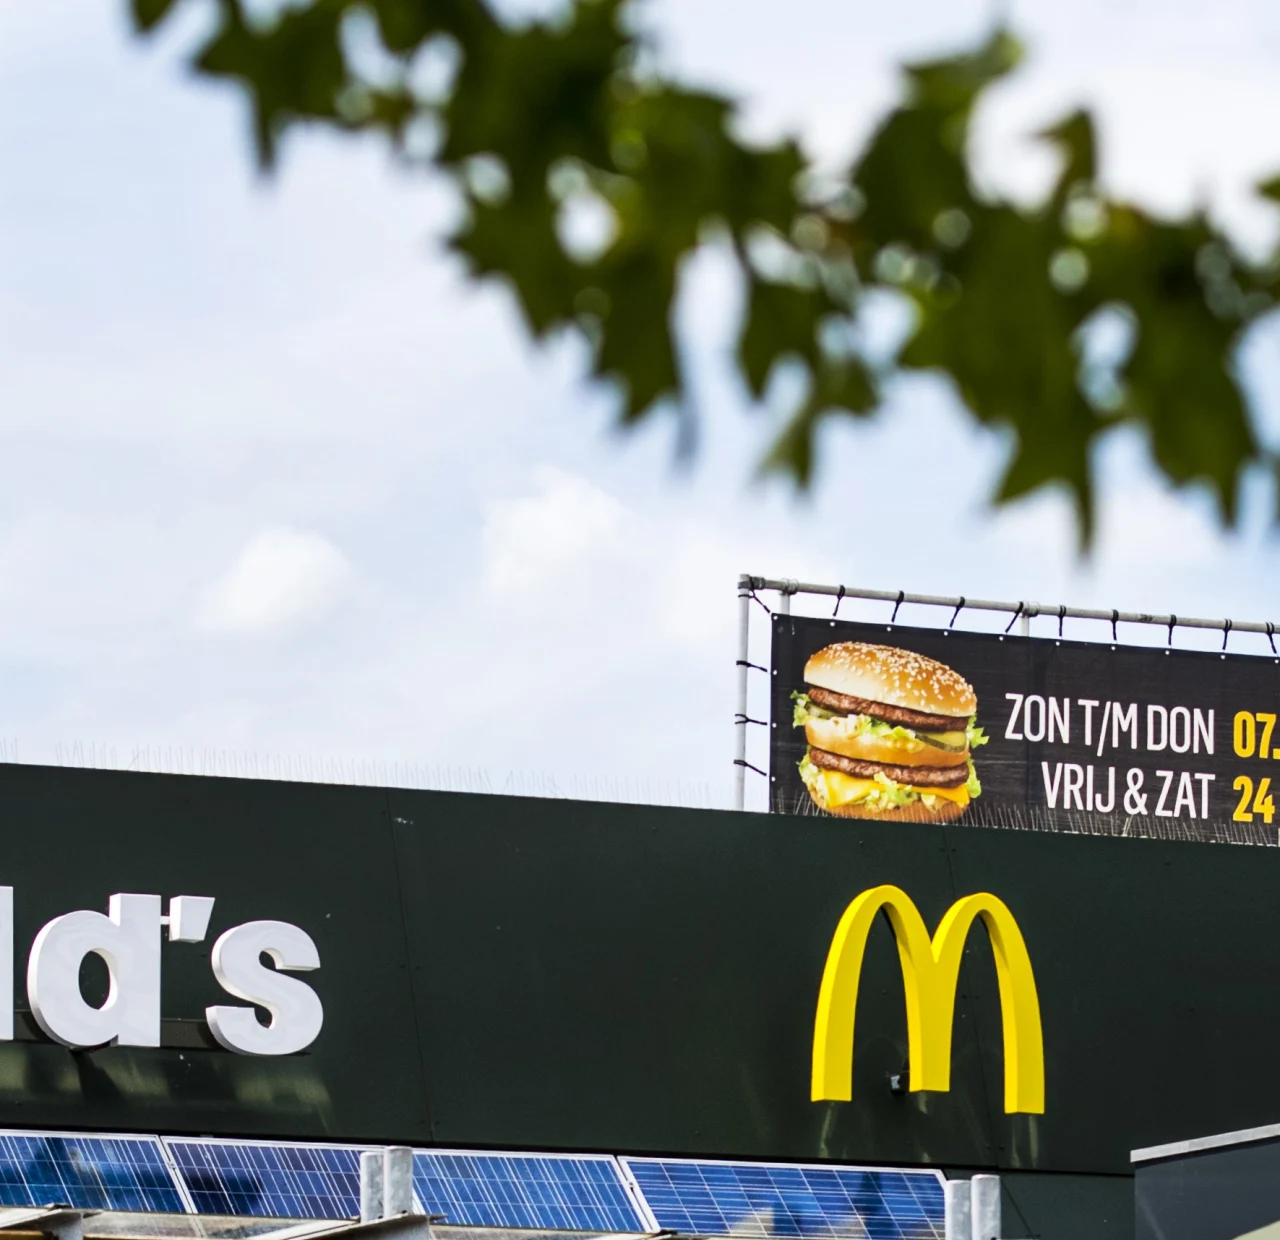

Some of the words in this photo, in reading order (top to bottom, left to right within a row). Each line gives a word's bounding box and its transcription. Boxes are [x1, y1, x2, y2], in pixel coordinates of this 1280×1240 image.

[1005, 692, 1070, 744] ZON
[1078, 699, 1138, 757] T/M
[1147, 704, 1215, 755] DON
[1041, 761, 1115, 813] VRIJ
[1123, 767, 1148, 815] &
[1155, 770, 1216, 819] ZAT
[1232, 775, 1275, 824] 24
